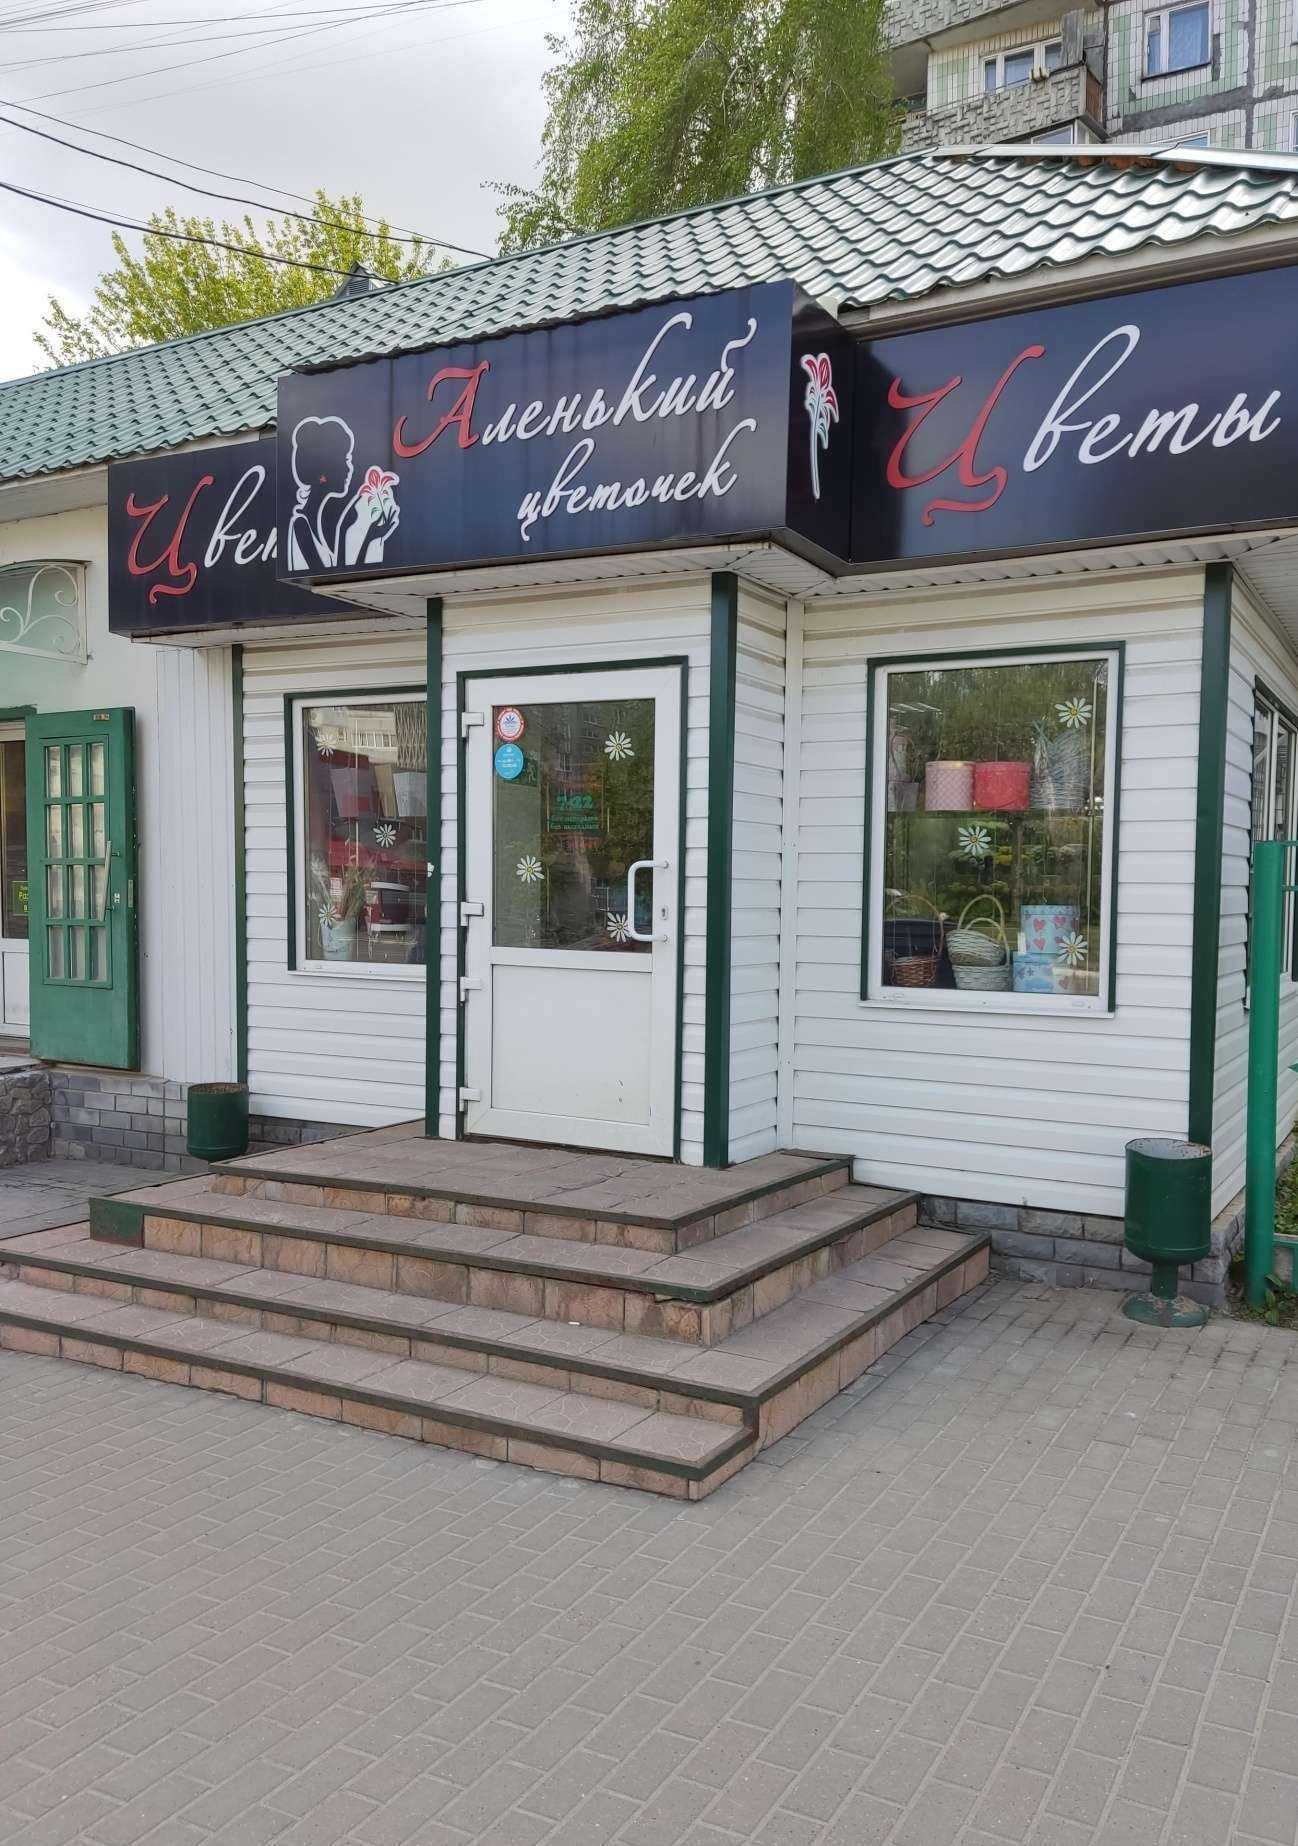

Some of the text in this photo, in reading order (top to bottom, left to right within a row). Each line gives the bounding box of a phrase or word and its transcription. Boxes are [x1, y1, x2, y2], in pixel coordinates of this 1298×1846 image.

[392, 312, 757, 458] Аленький
[886, 324, 1282, 527] Цветы
[517, 418, 757, 541] цветочек
